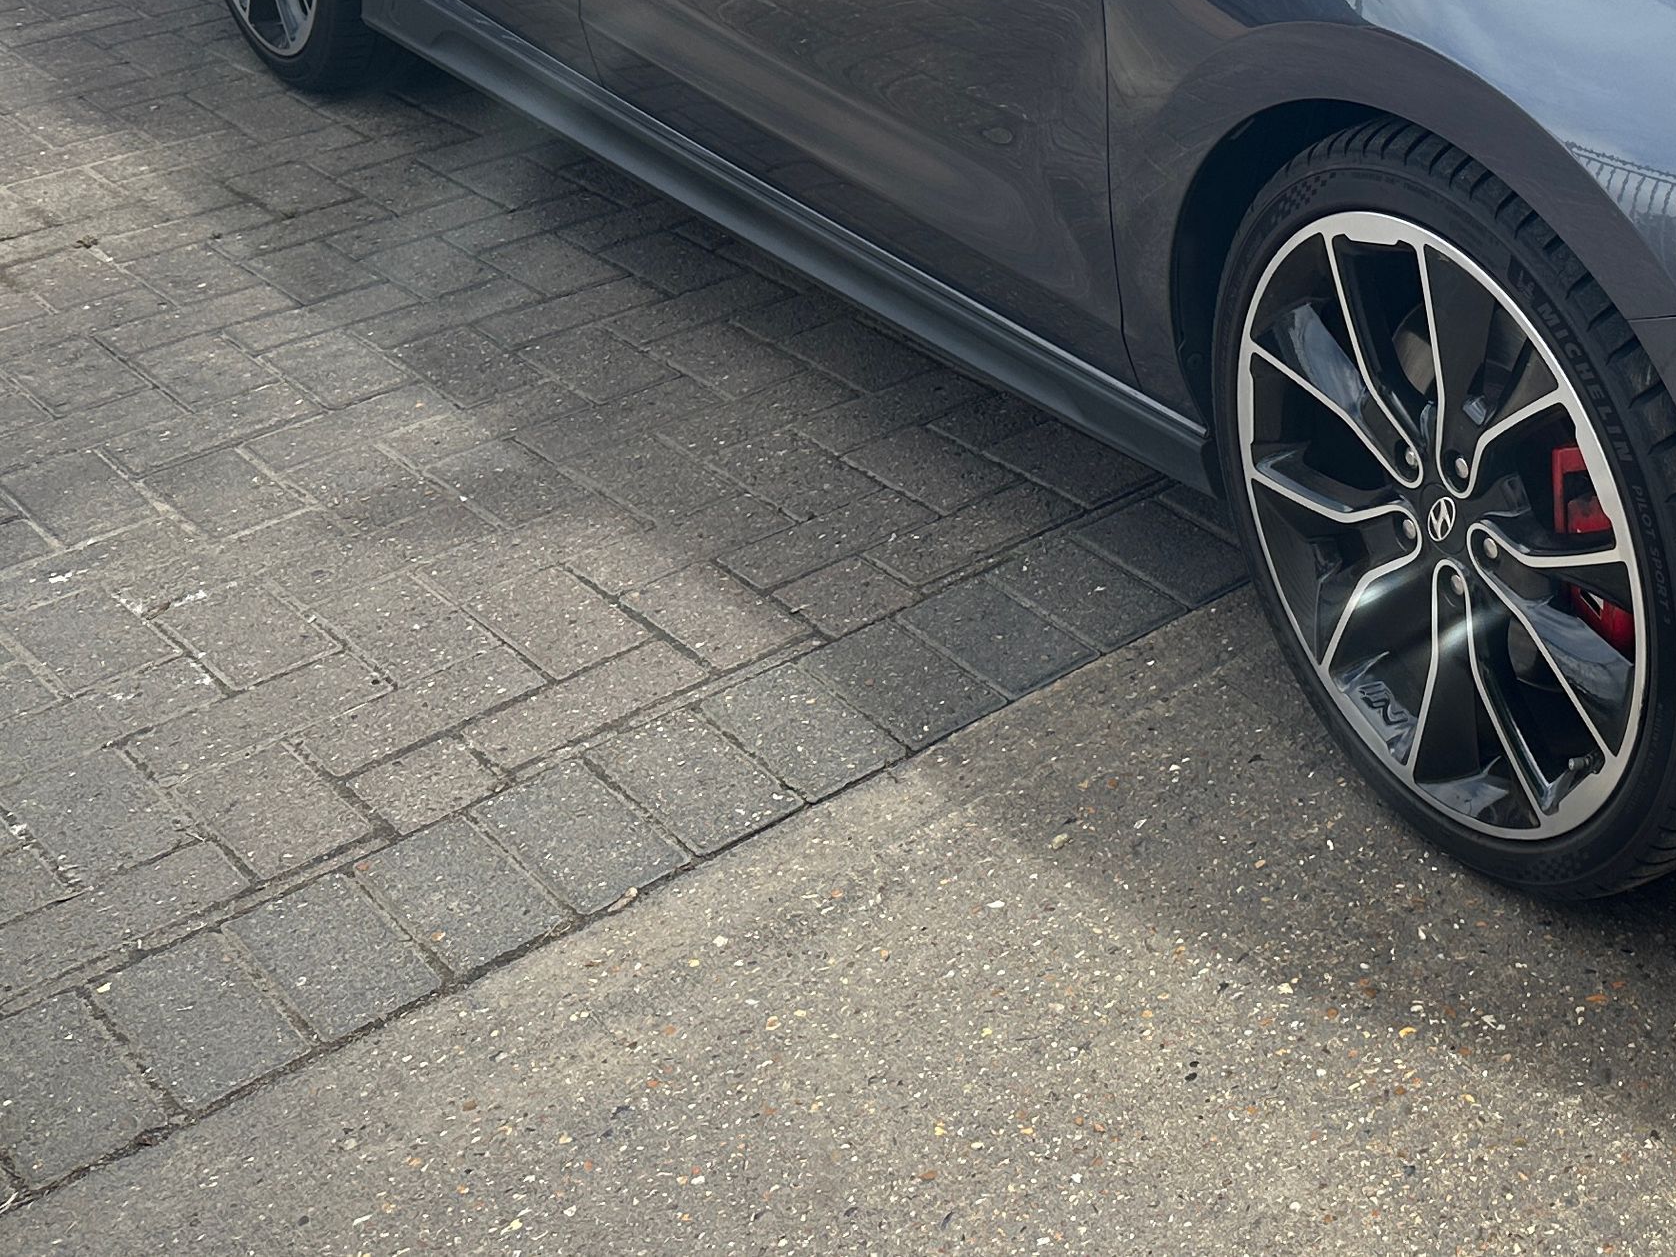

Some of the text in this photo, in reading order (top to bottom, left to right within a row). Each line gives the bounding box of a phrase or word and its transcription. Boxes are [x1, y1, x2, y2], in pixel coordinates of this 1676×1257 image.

[1536, 301, 1634, 461] MICHELIN
[1632, 485, 1656, 539] PILOT
[1651, 547, 1671, 612] SPORT
